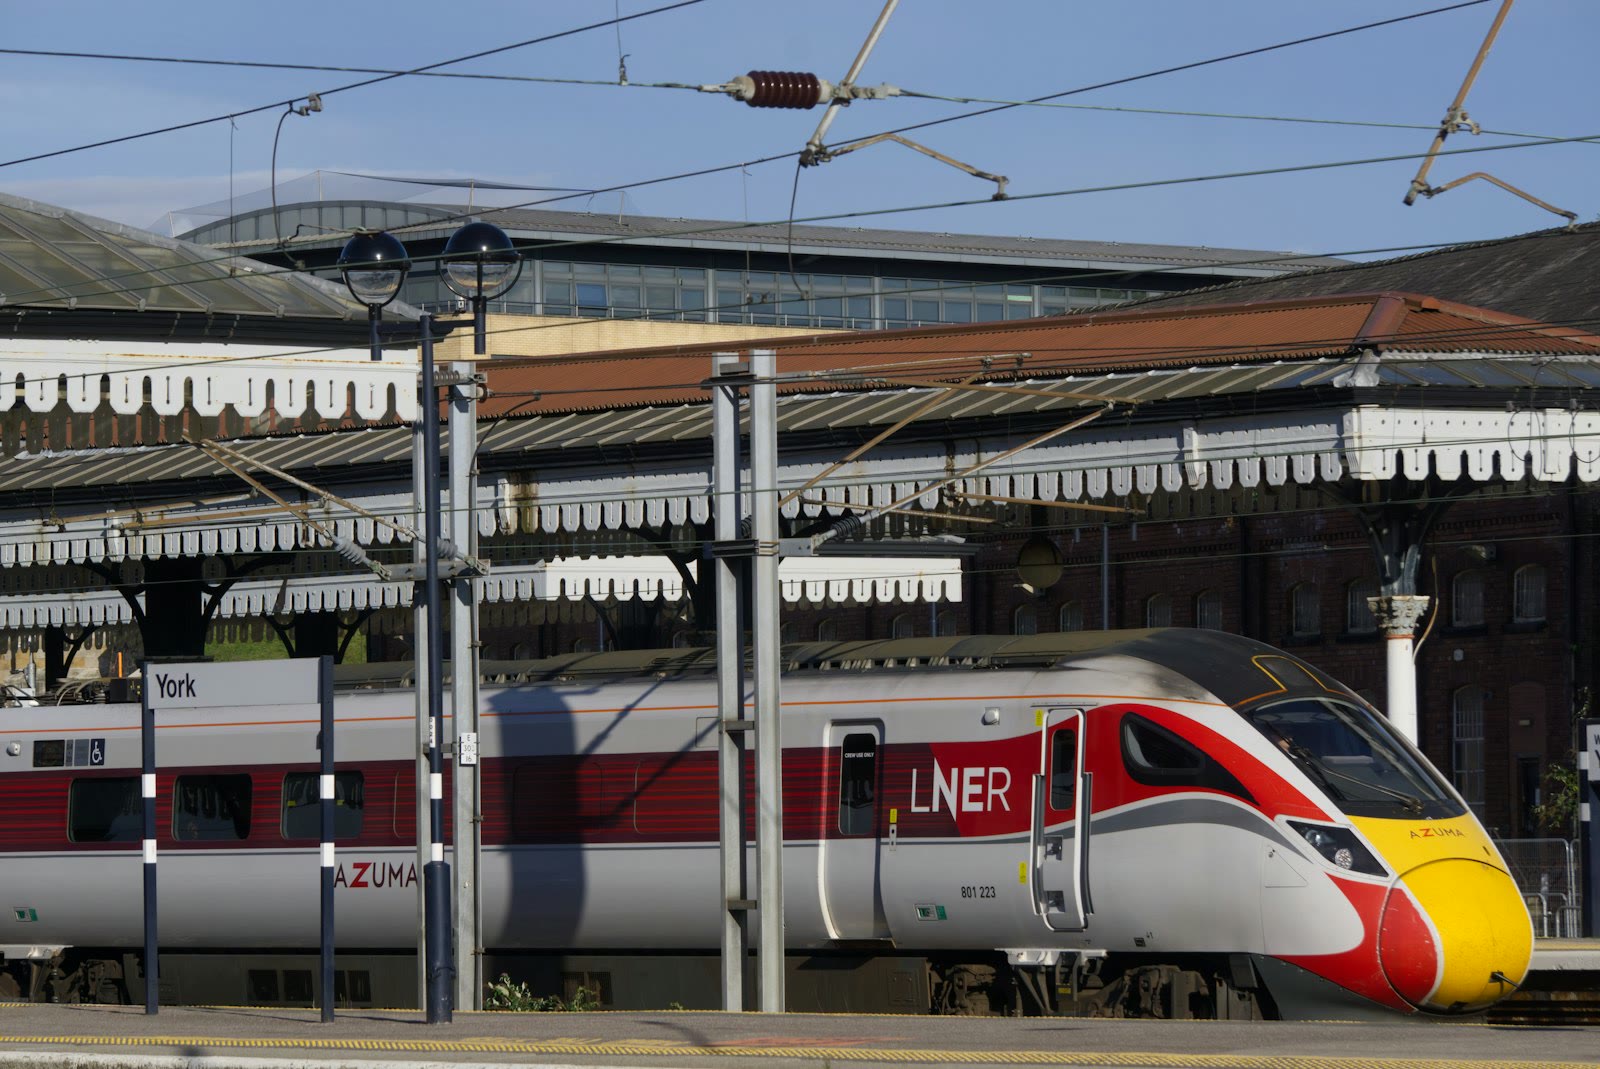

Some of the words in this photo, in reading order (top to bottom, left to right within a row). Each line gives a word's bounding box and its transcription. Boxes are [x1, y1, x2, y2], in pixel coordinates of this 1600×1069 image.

[155, 673, 196, 698] York
[911, 757, 1011, 822] LNER
[1410, 827, 1466, 839] AZUMA
[334, 862, 418, 888] AZUMA
[961, 886, 977, 898] 801
[979, 886, 996, 898] 223
